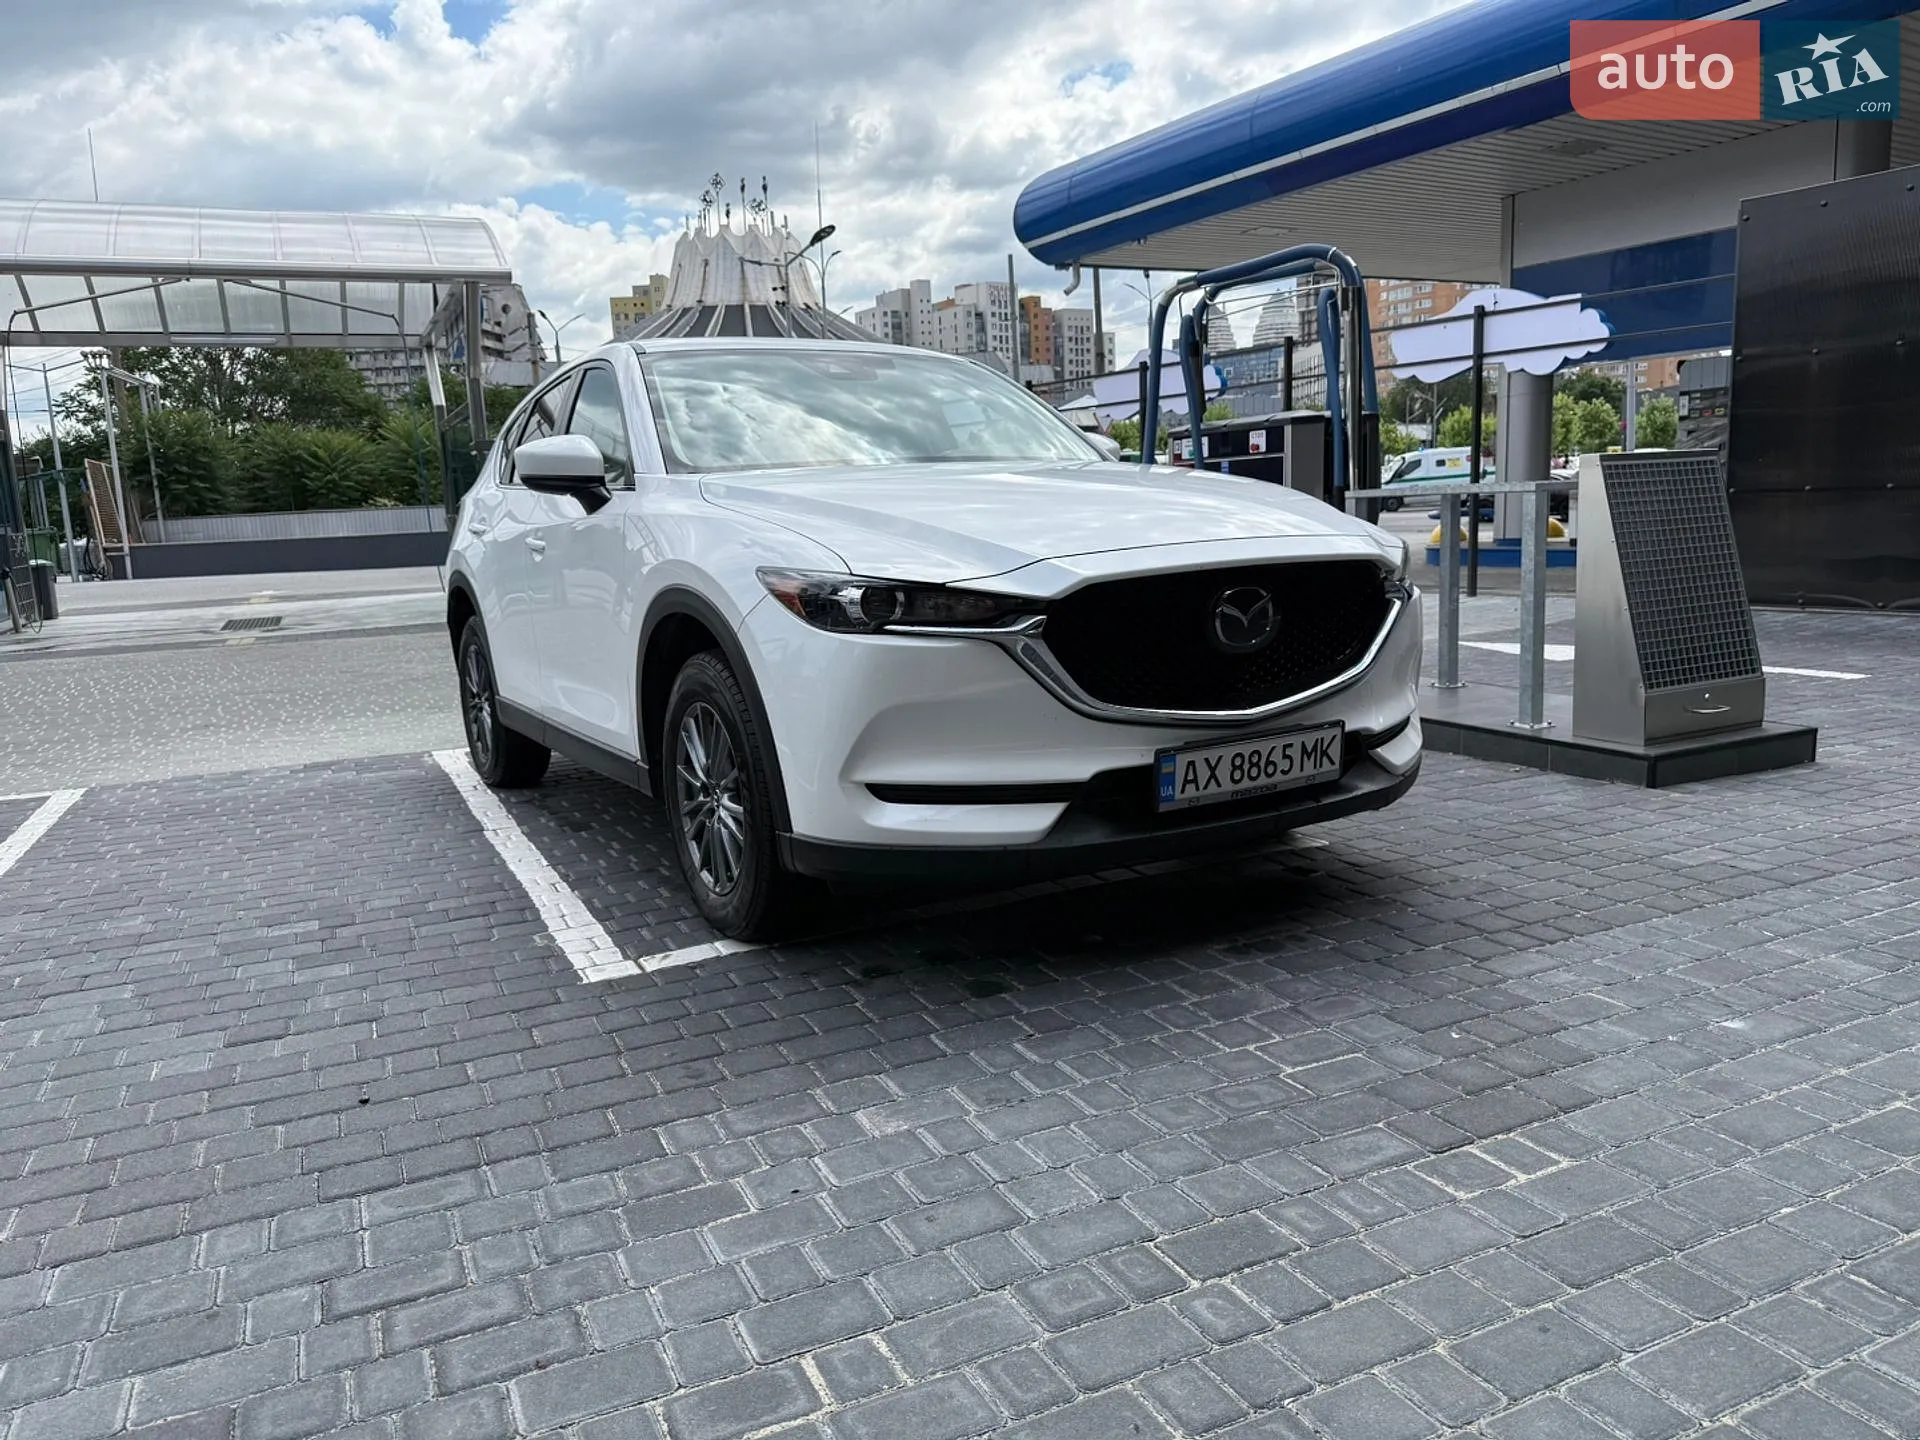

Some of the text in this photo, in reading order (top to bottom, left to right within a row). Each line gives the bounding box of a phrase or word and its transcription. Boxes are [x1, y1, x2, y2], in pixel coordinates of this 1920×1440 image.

[1180, 735, 1337, 794] AX 8865 MK
[1160, 786, 1173, 798] UA
